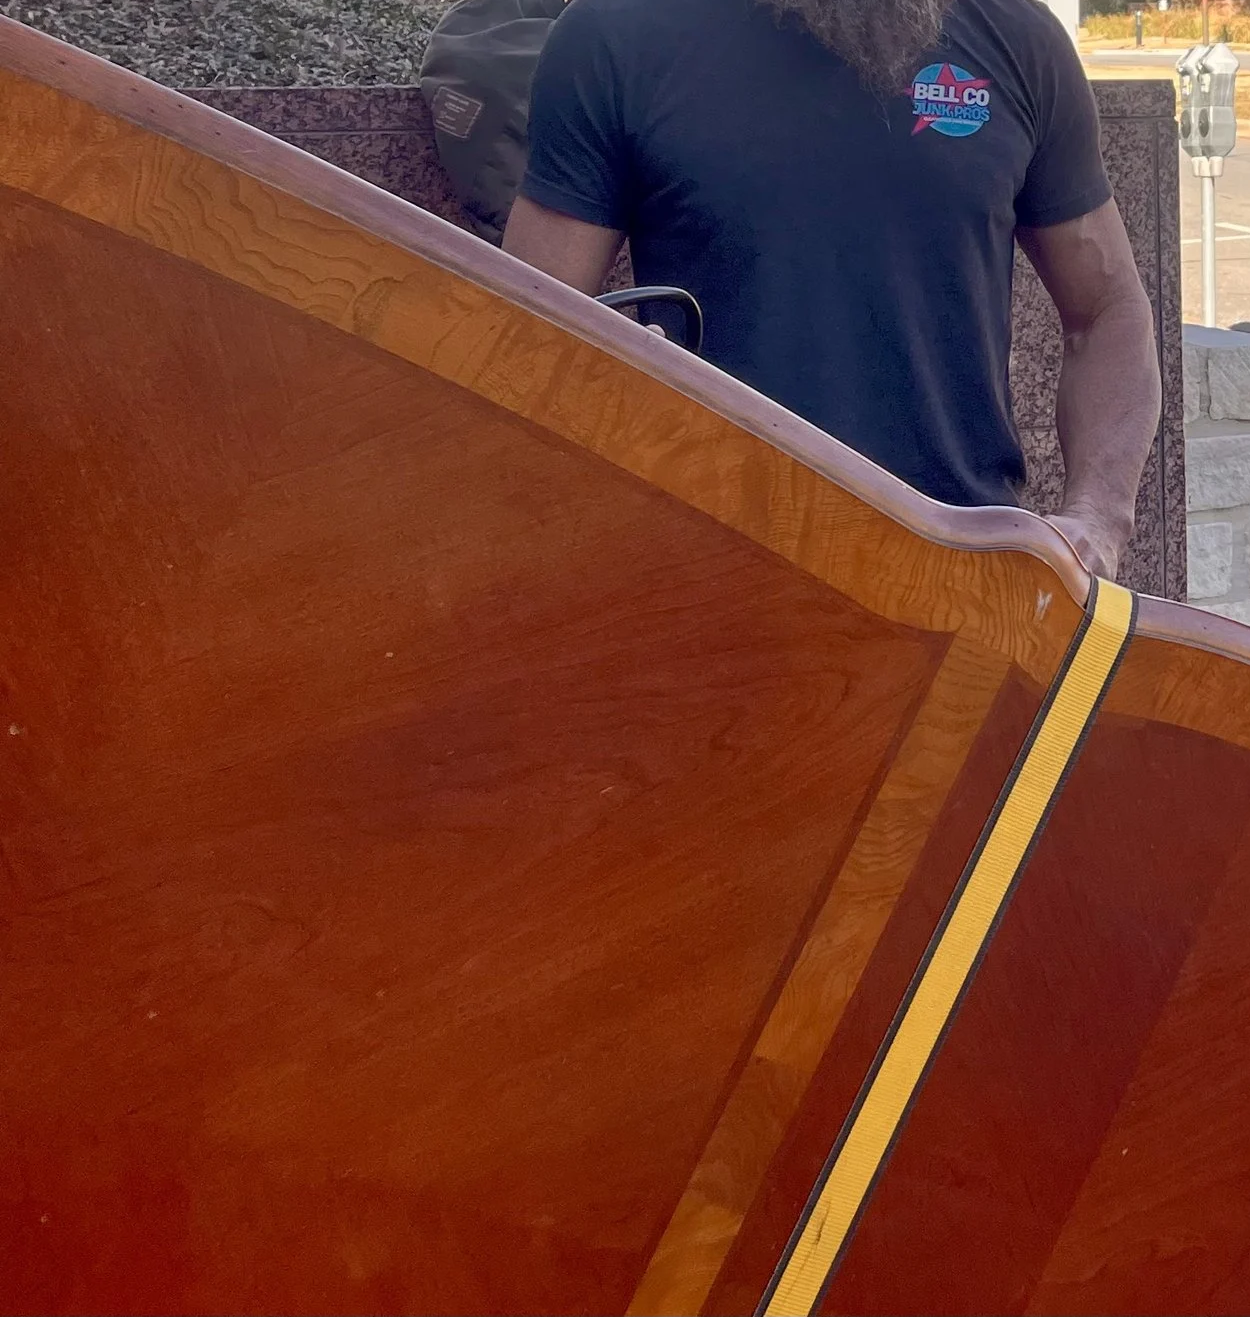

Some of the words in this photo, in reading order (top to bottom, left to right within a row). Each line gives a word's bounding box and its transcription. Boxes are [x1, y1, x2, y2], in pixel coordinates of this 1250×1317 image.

[914, 83, 960, 103] BELL
[963, 87, 990, 107] CO
[912, 102, 952, 117] JUNK
[954, 105, 991, 122] PROS
